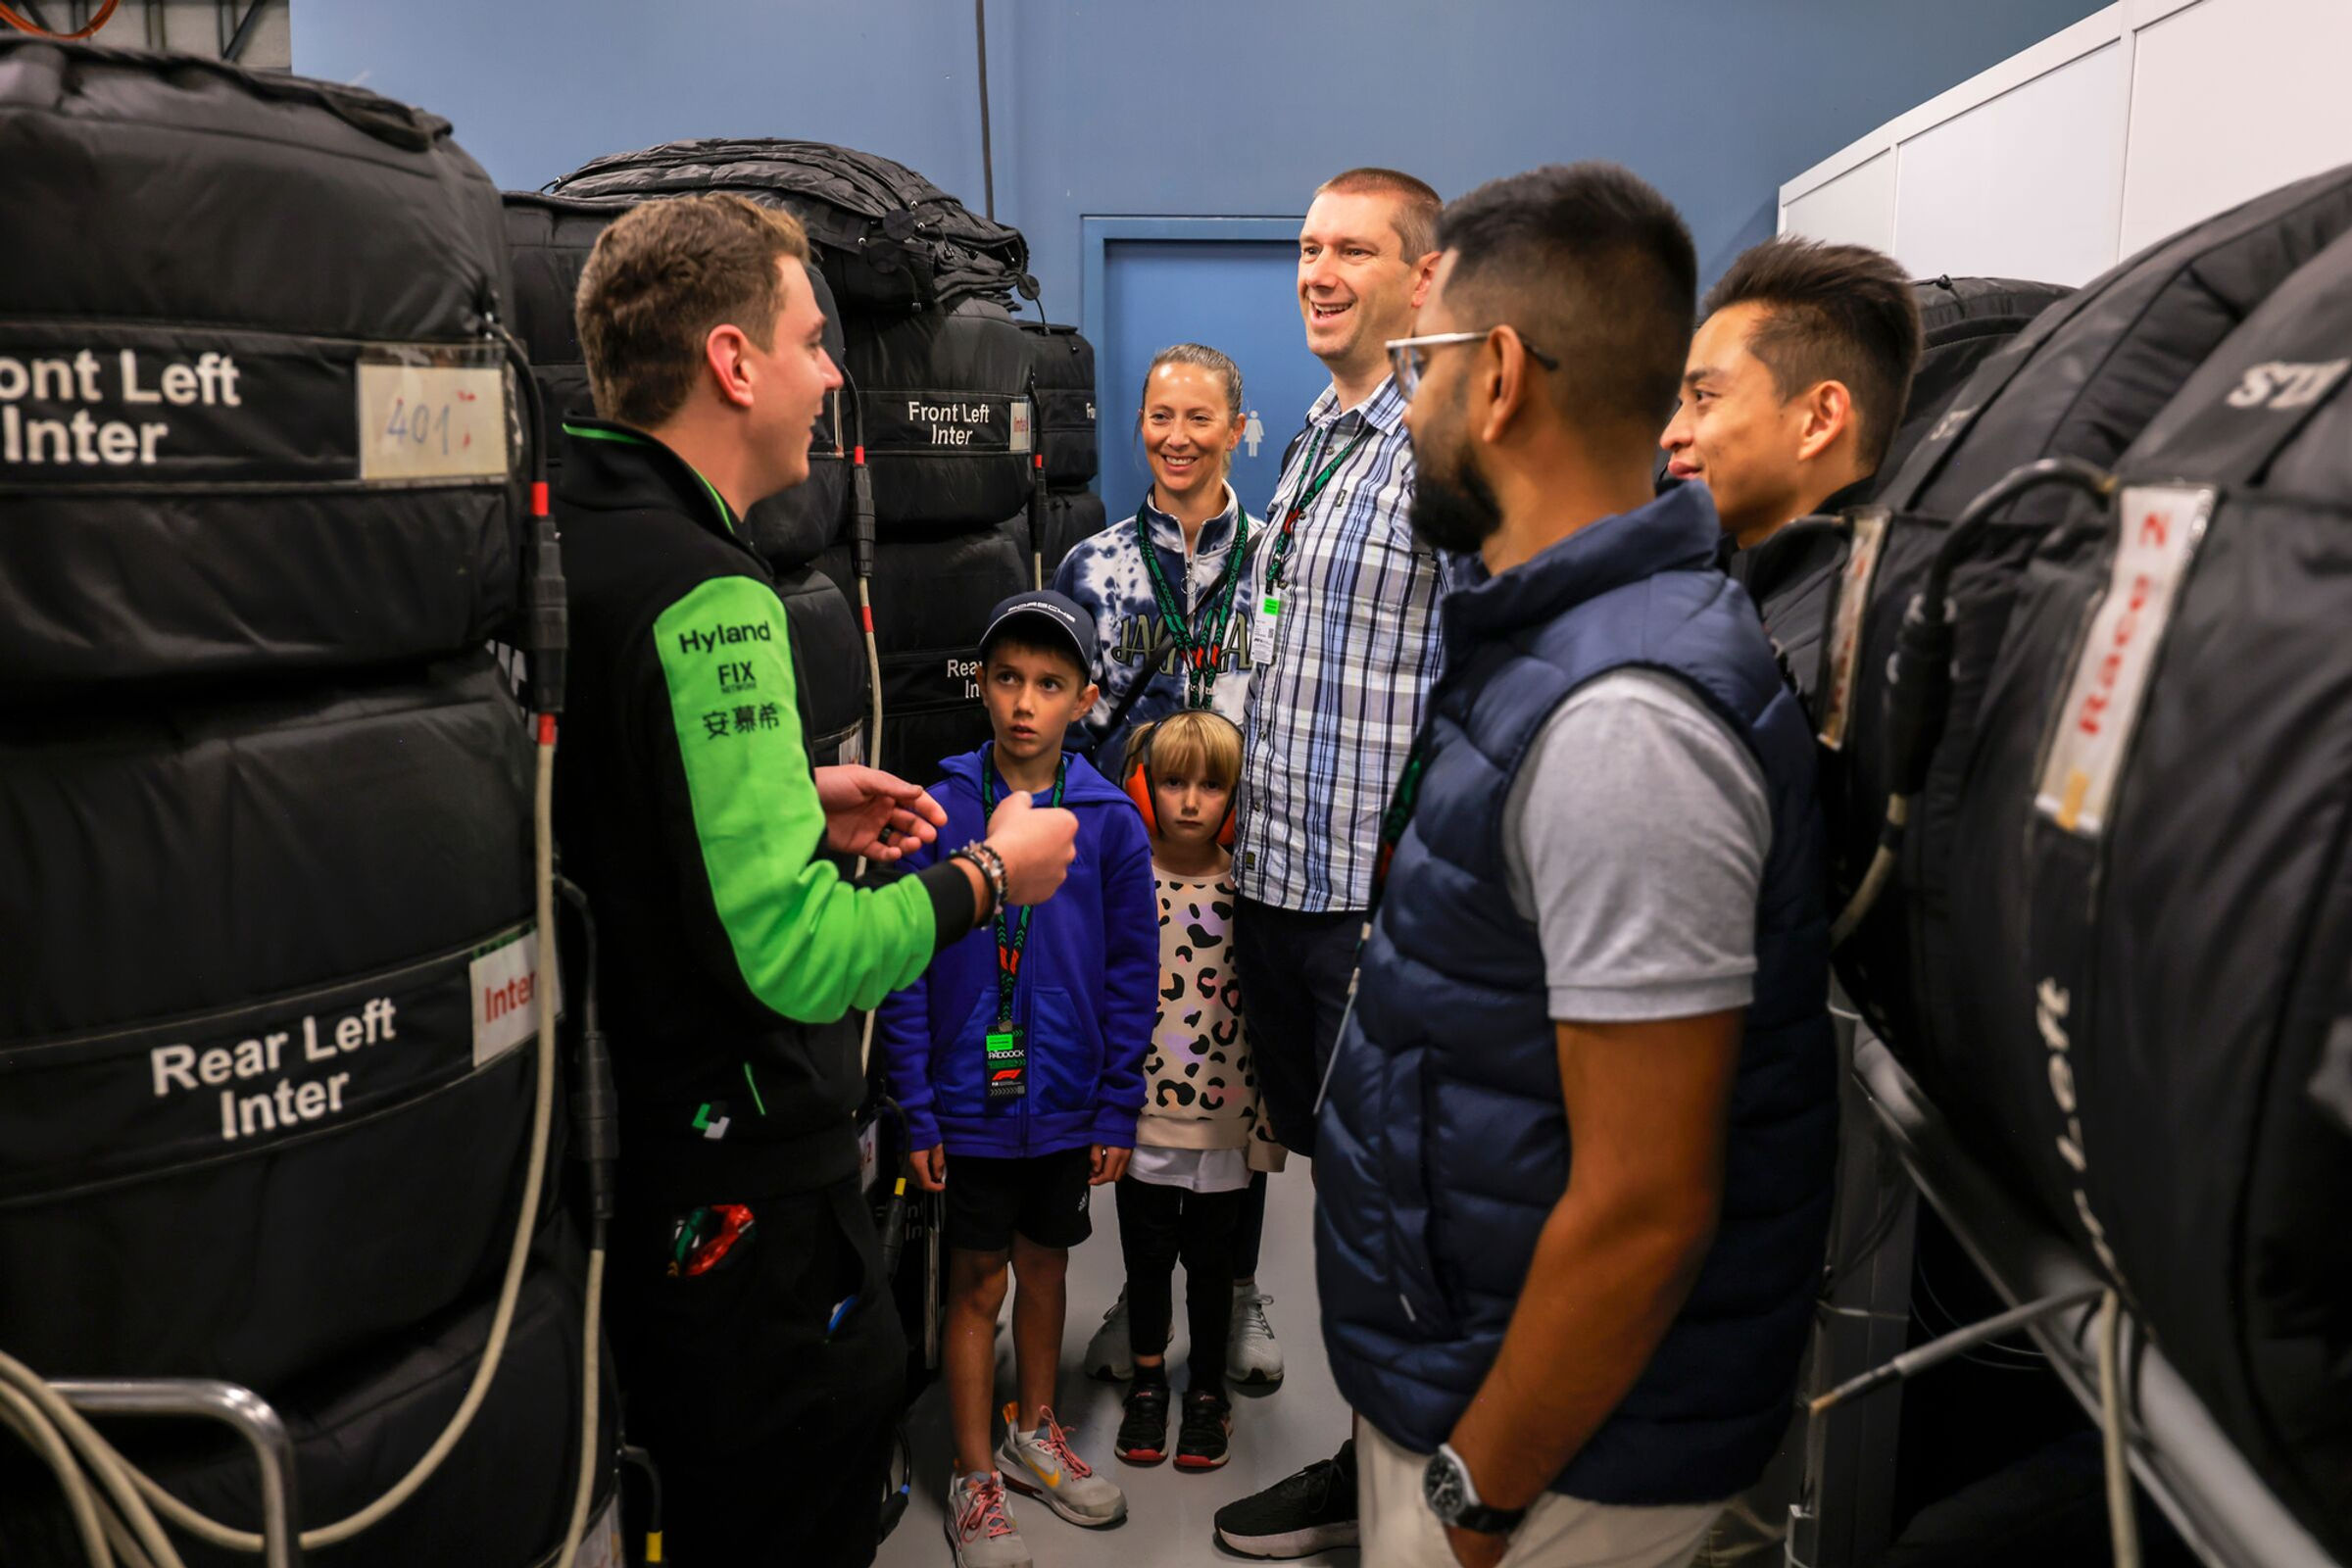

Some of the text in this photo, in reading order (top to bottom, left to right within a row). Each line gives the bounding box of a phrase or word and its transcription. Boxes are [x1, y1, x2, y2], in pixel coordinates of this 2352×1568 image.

[121, 349, 241, 406] Left
[908, 402, 990, 423] Front Left
[3, 406, 169, 465] Inter
[931, 424, 973, 445] Inter
[1008, 602, 1076, 622] PORSCHE
[677, 620, 772, 655] Hyland
[717, 661, 756, 686] FIX
[703, 702, 780, 740] 安慕希
[150, 997, 397, 1096] Rear Left
[220, 1071, 350, 1141] Inter
